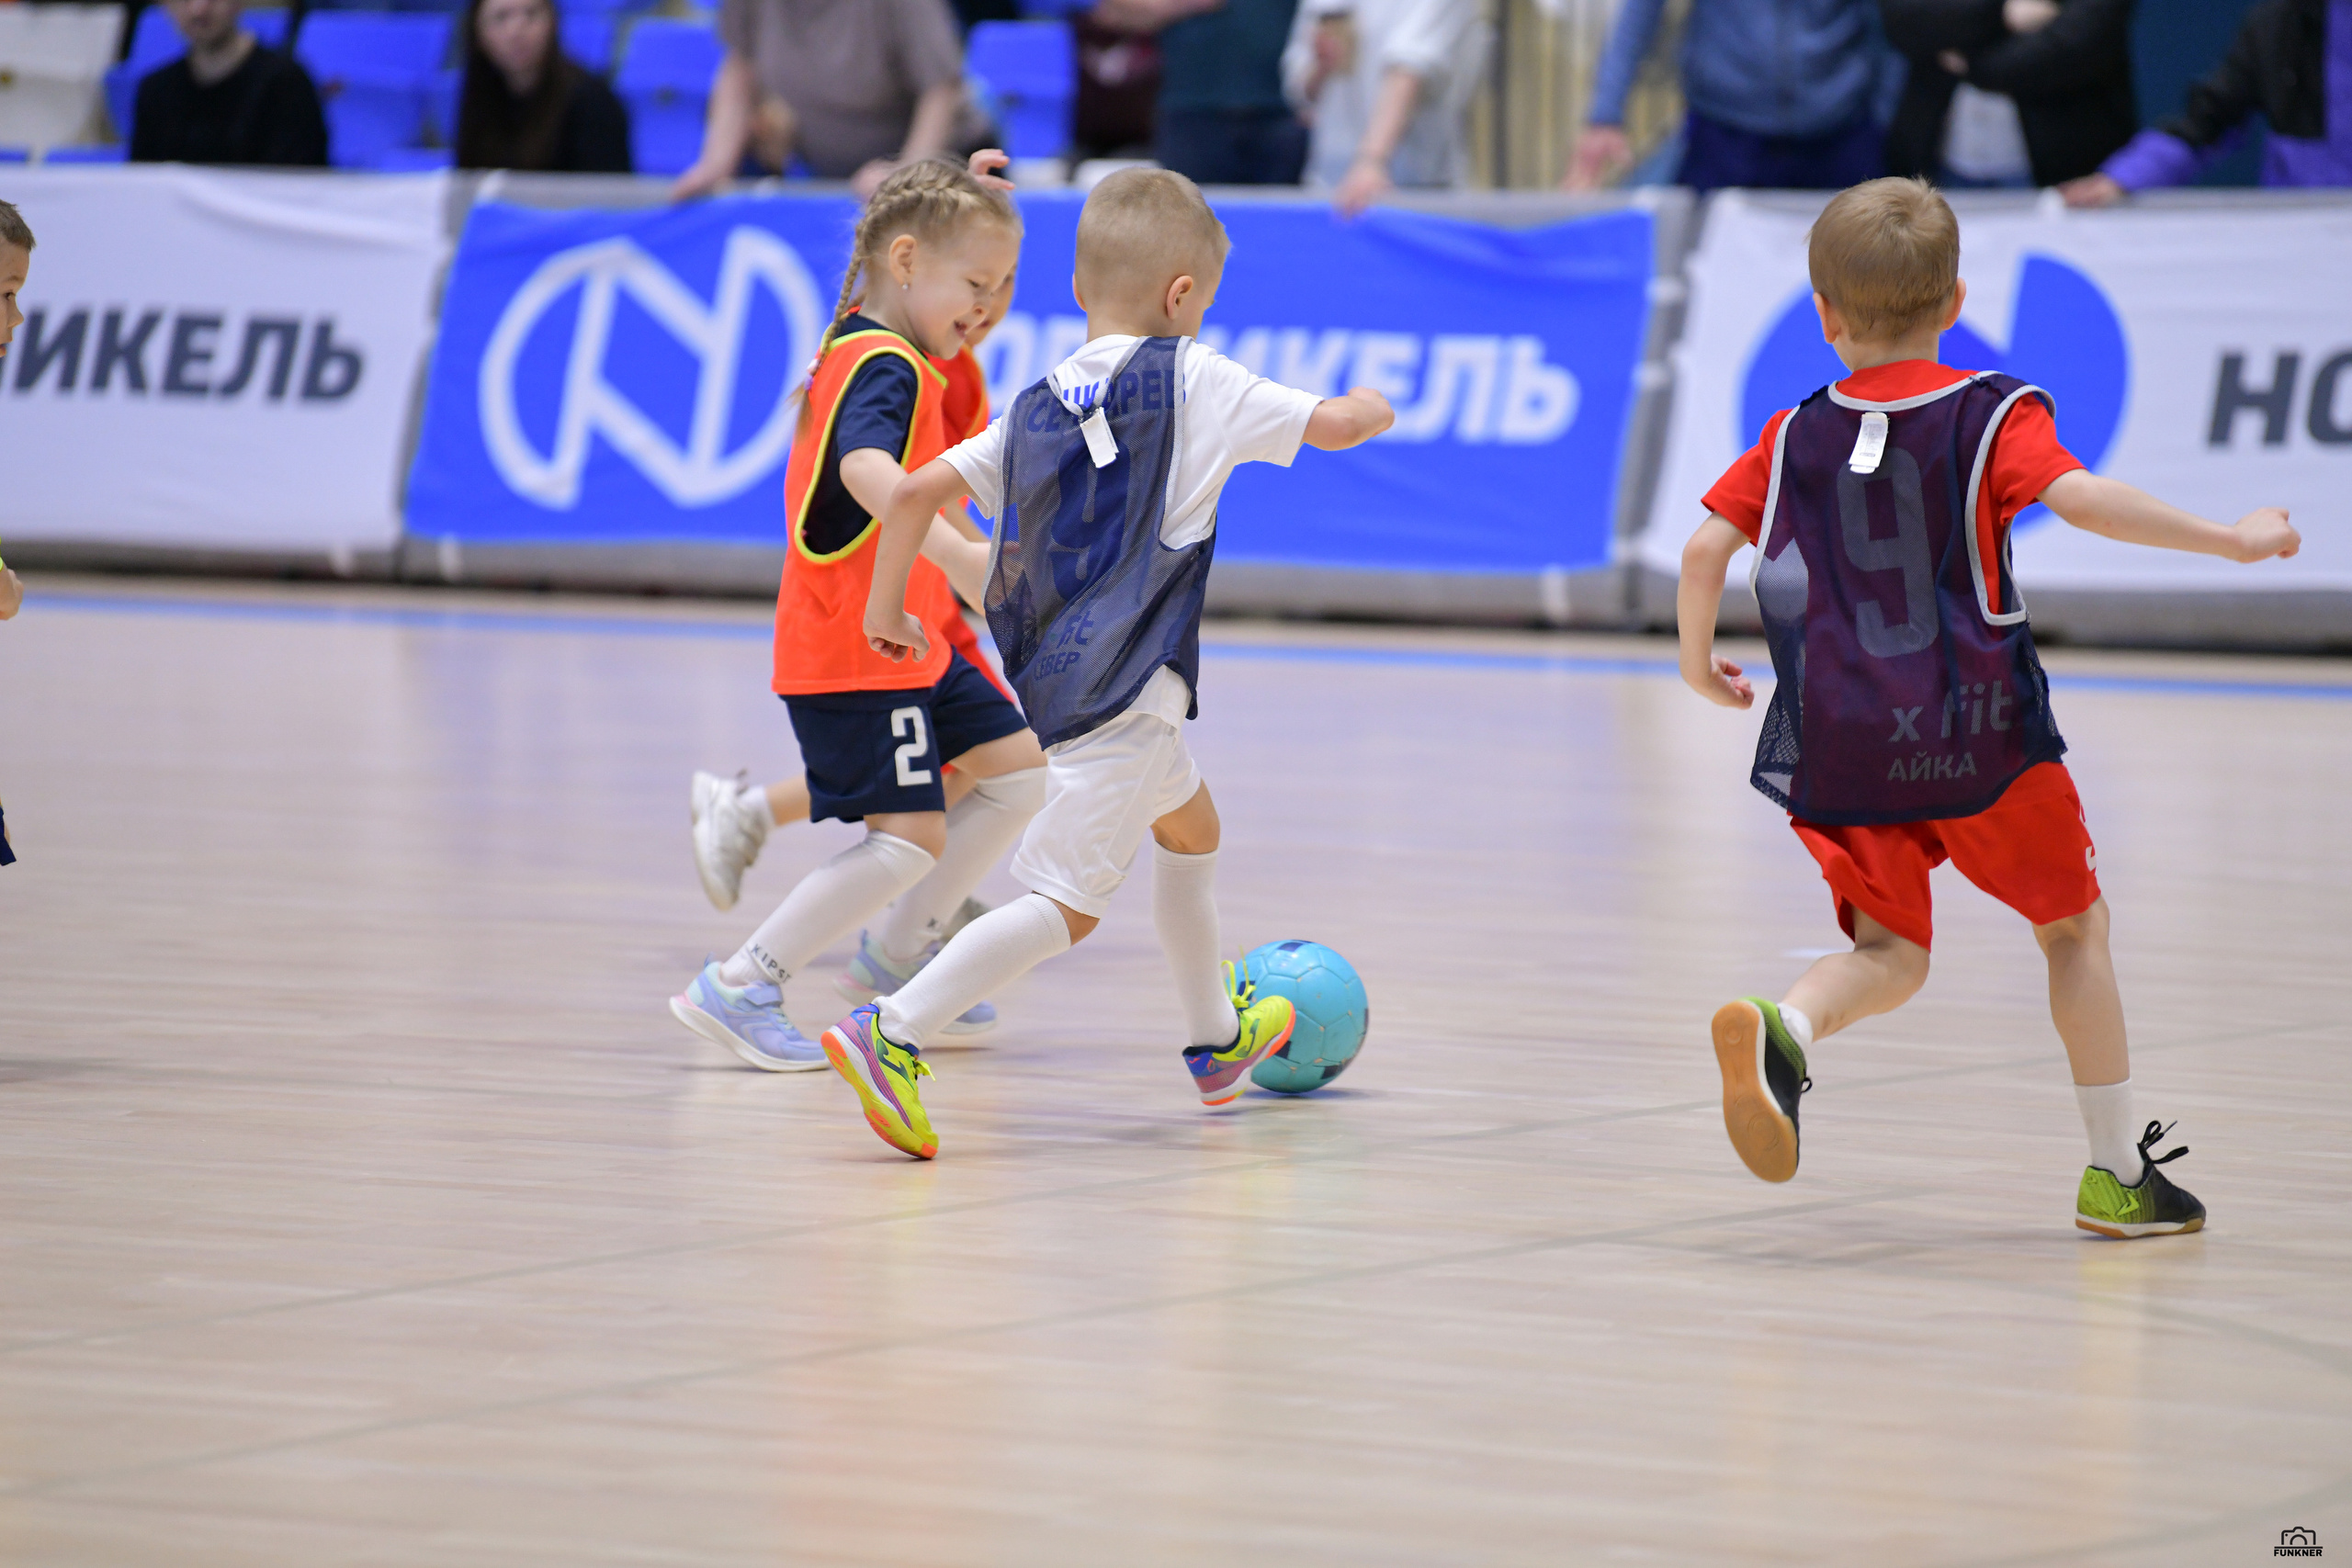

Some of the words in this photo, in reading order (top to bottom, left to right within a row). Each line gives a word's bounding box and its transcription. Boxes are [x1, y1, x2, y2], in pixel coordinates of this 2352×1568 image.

[2, 307, 366, 404] ИКЕЛЬ
[1838, 447, 1939, 658] 9
[890, 705, 933, 786] 2
[1887, 751, 1977, 781] АЙКА
